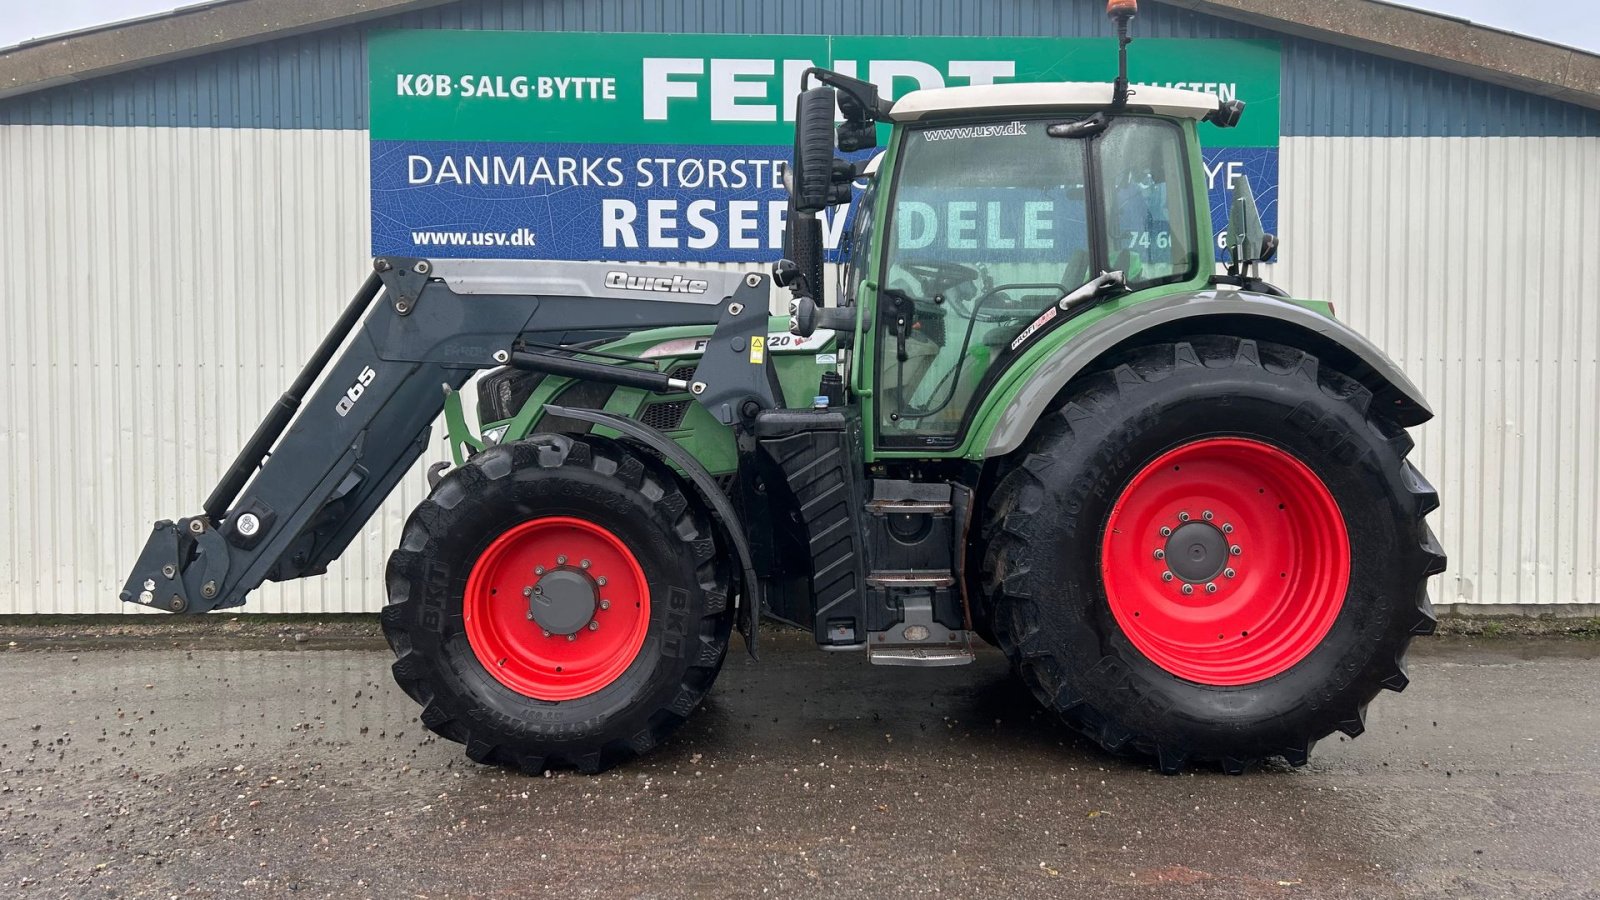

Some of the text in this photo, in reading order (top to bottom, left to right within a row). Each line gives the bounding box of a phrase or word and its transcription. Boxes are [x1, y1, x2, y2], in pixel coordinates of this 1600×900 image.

[923, 121, 1027, 141] www.usv.dk
[408, 155, 789, 189] DANMARKS STØRSTE
[602, 199, 1055, 249] RESERVDELE
[412, 228, 536, 247] www.usv.dk
[1128, 231, 1150, 249] 74
[604, 271, 708, 294] Quicke
[335, 365, 376, 417] Q65
